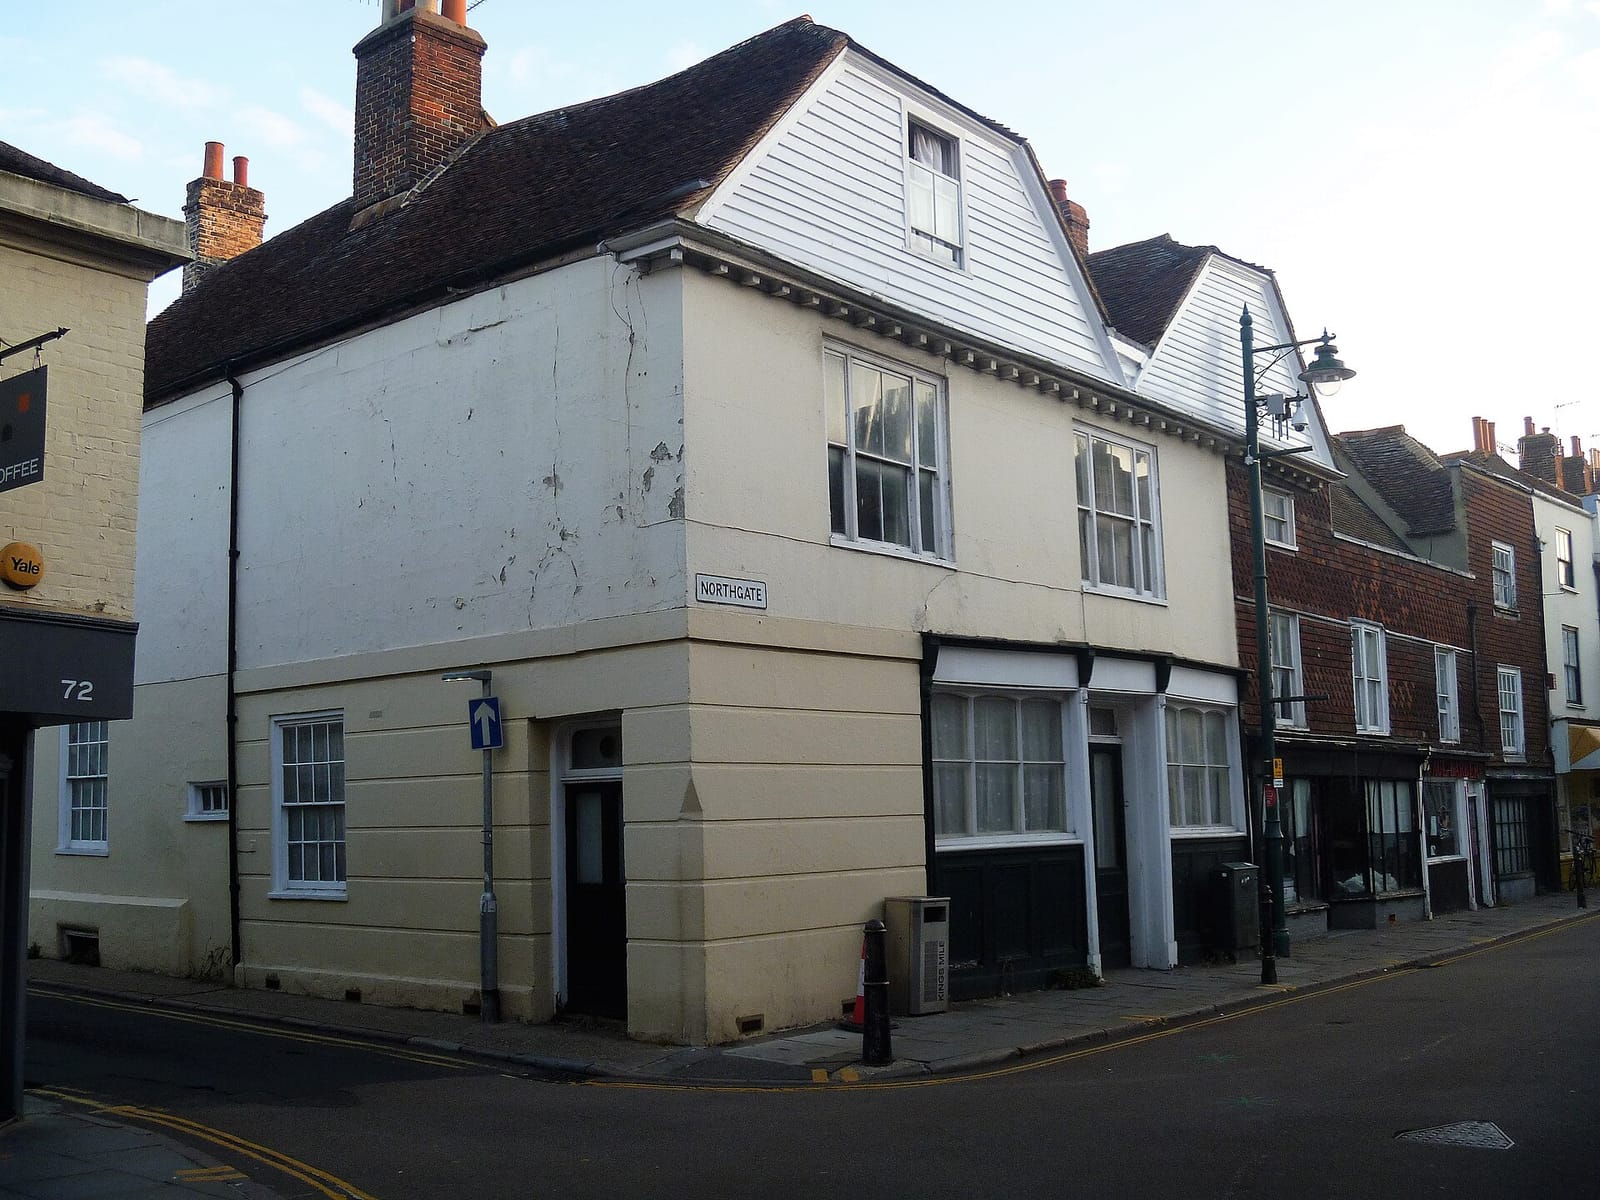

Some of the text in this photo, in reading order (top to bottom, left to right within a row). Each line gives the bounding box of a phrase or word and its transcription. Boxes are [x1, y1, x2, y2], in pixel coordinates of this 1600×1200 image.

[11, 557, 40, 575] Yale
[701, 580, 762, 601] NORTHGATE
[61, 679, 94, 701] 72
